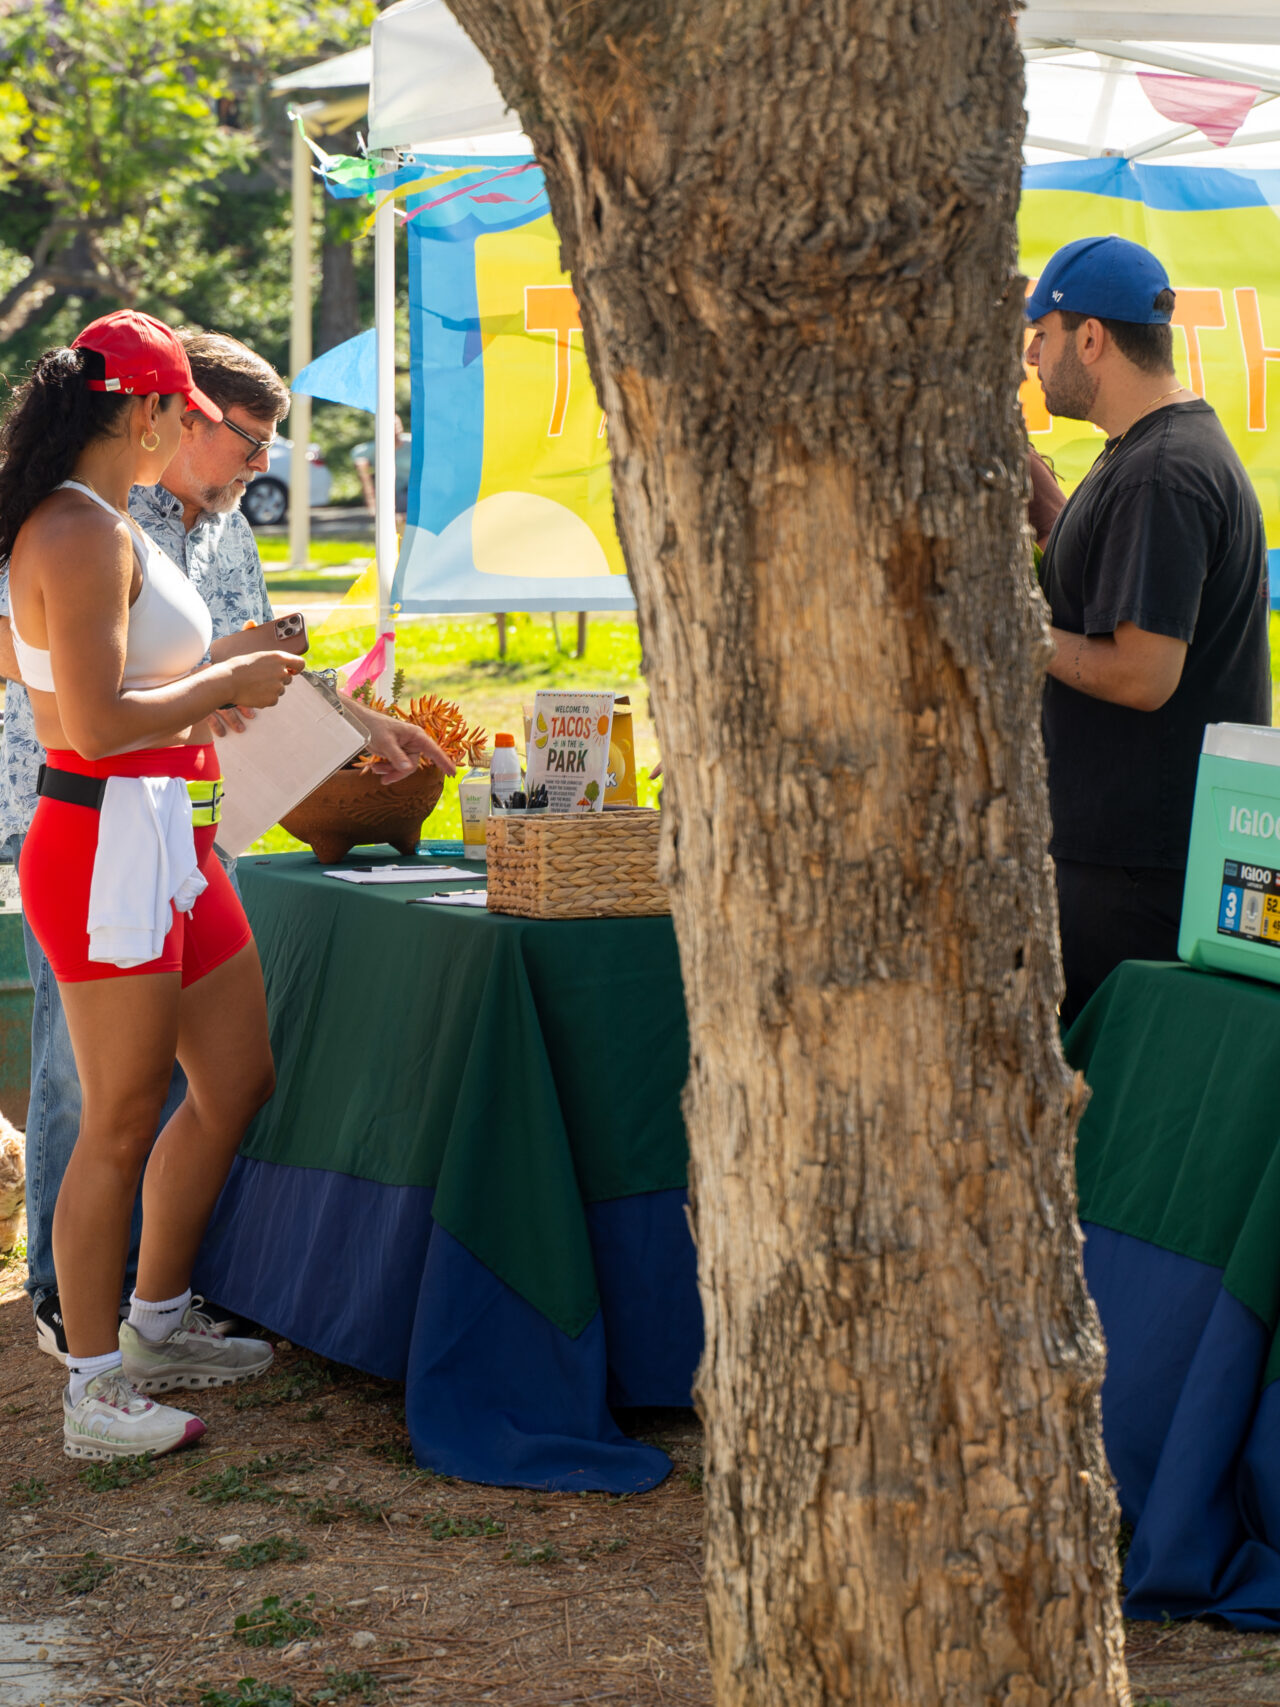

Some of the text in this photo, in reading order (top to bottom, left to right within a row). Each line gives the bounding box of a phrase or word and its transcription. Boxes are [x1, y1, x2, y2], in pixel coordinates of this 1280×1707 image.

[555, 705, 590, 714] WELCOME TO
[551, 716, 592, 739] TACOS
[560, 740, 577, 748] IN THE
[546, 748, 588, 773] PARK
[1241, 864, 1272, 884] IGLOO
[1225, 892, 1238, 918] 3
[1267, 897, 1278, 913] 52
